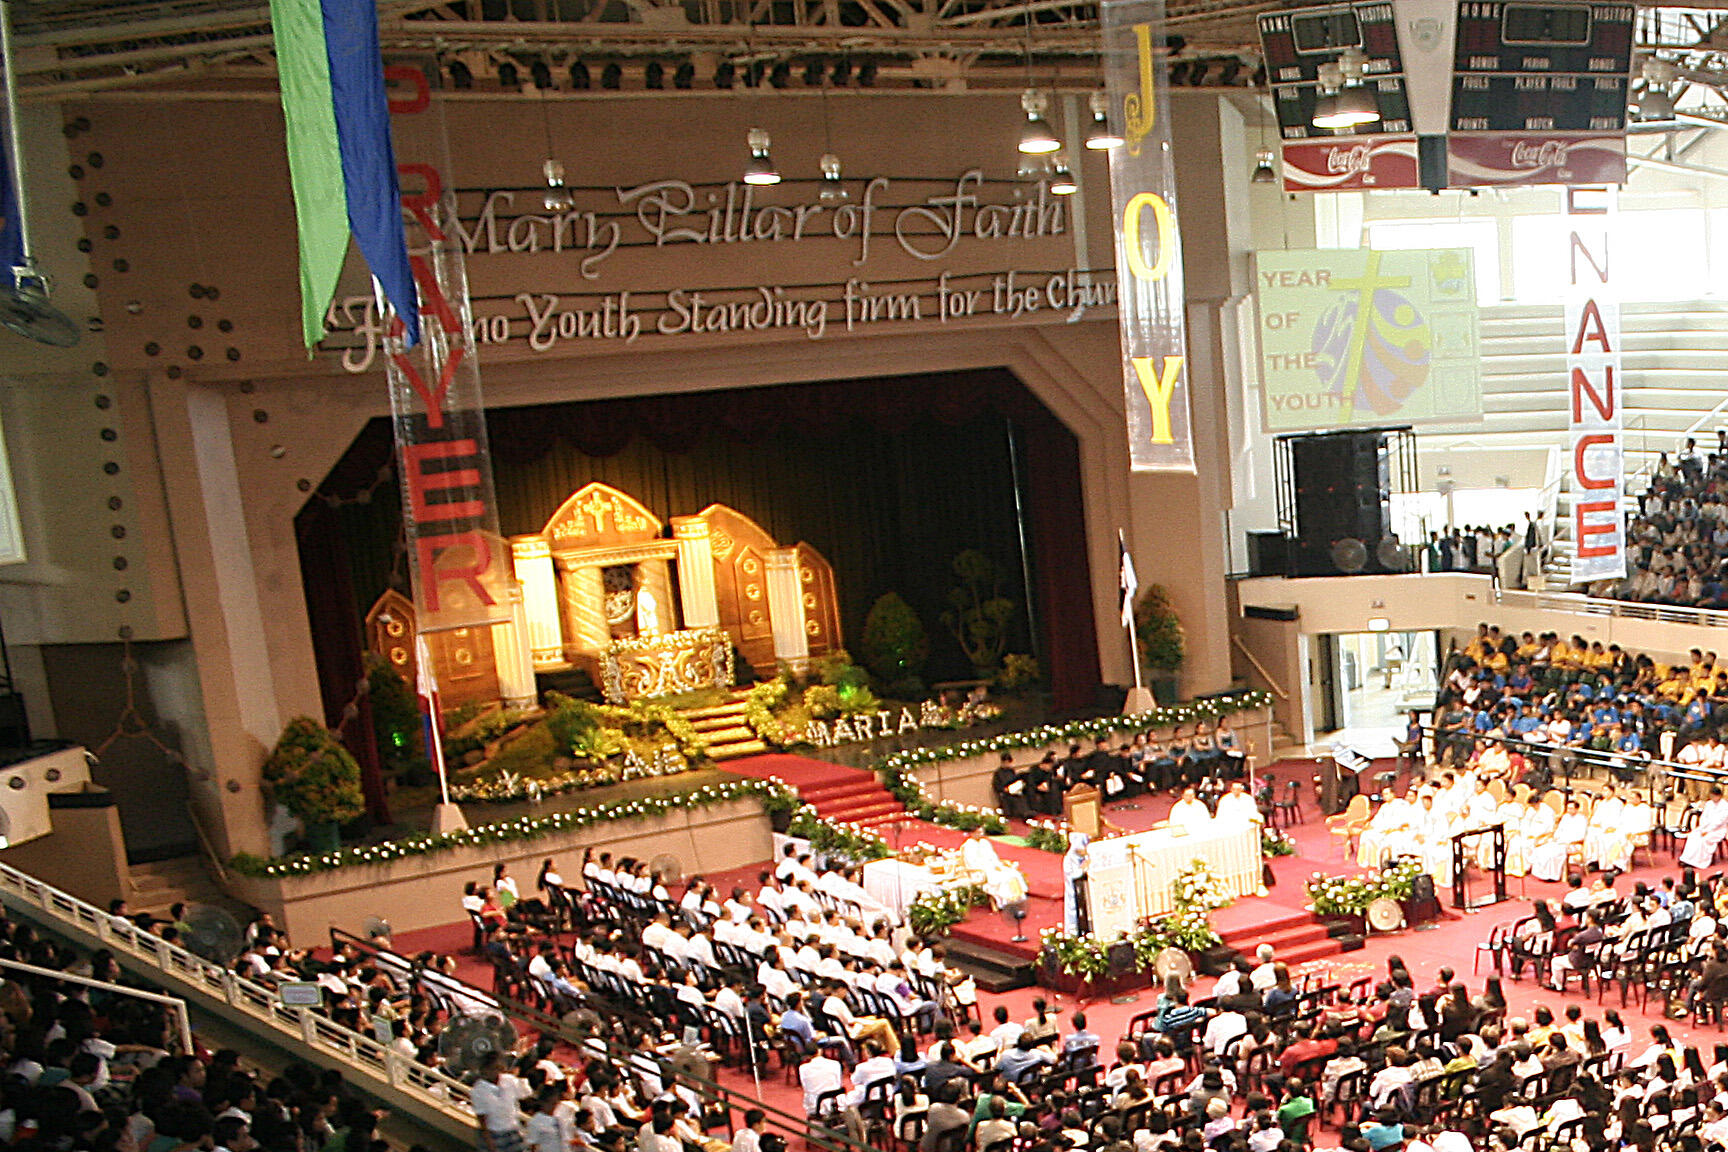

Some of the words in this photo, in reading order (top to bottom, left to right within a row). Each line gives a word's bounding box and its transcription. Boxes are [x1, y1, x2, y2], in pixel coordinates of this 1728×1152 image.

[404, 190, 622, 280] Mary
[616, 182, 823, 247] Pillar
[833, 176, 888, 266] of
[896, 170, 1065, 260] Faith
[1123, 24, 1183, 444] JOY
[1261, 269, 1331, 288] YEAR
[514, 290, 640, 350] Youth
[657, 285, 829, 340] Standing
[844, 276, 921, 331] firm
[938, 271, 983, 323] for
[992, 270, 1039, 318] the
[1048, 268, 1116, 323] Chur
[1265, 311, 1300, 330] OF
[1266, 351, 1319, 370] THE
[1270, 391, 1352, 411] YOUTH
